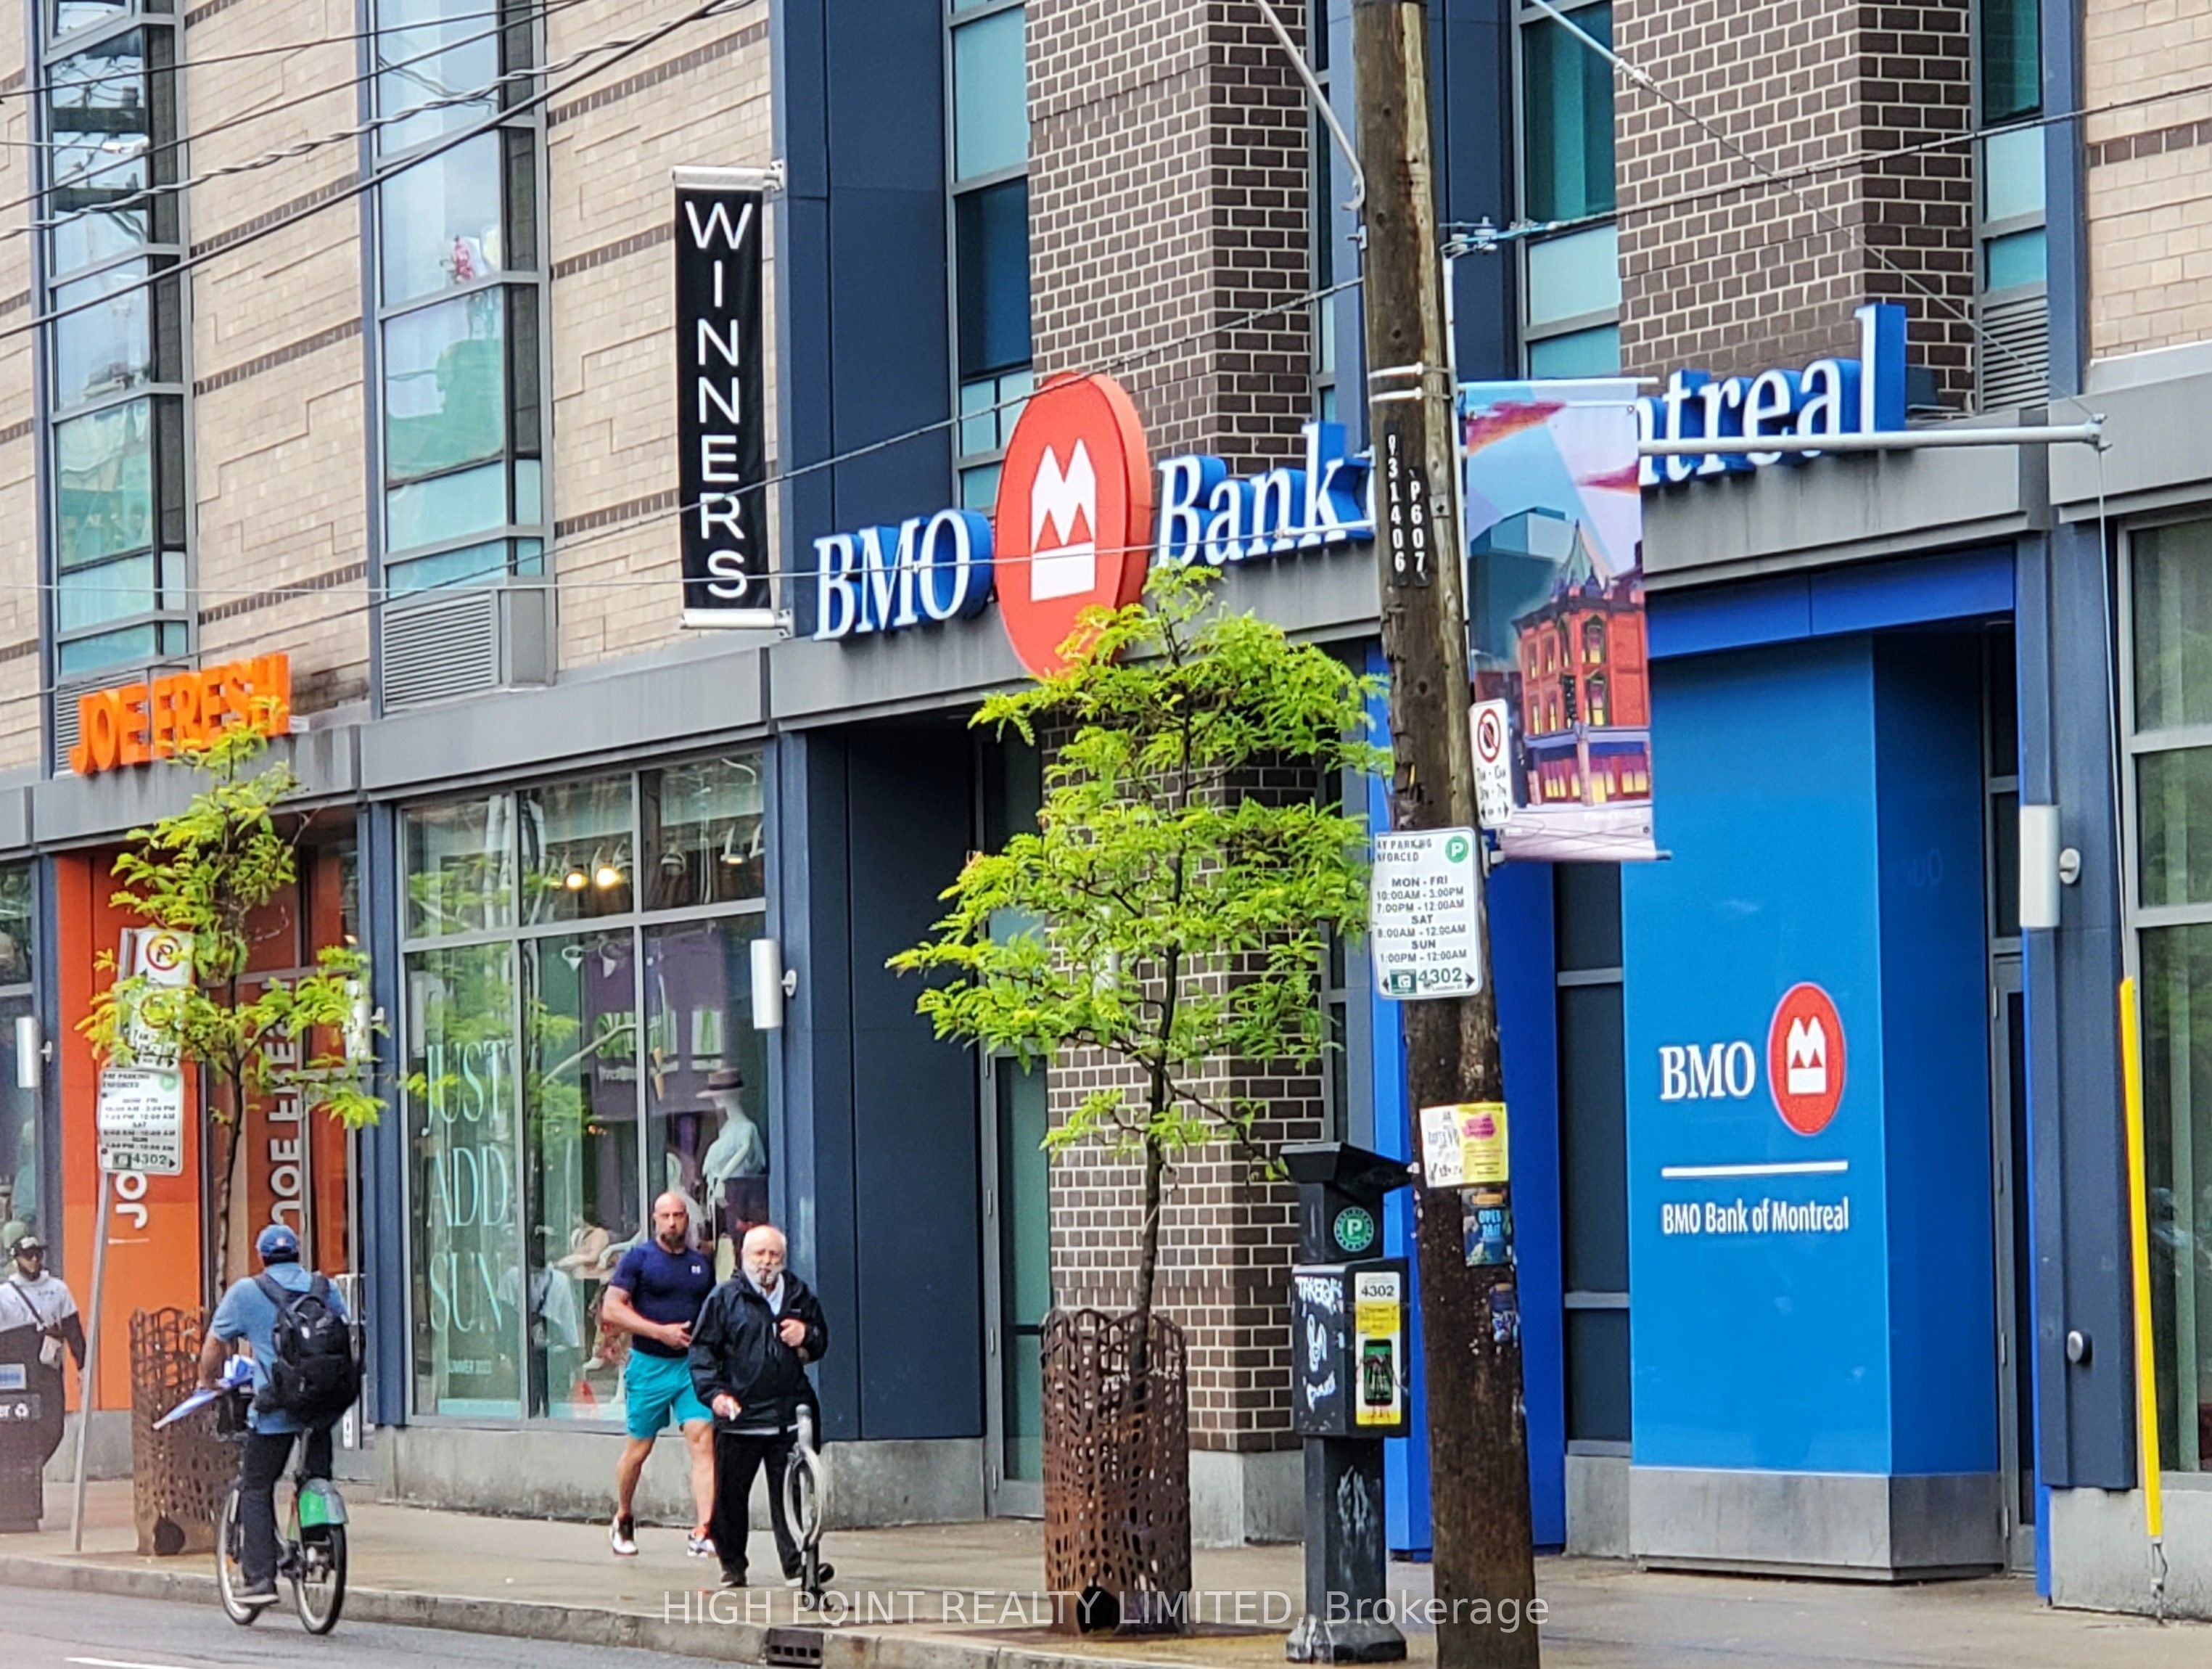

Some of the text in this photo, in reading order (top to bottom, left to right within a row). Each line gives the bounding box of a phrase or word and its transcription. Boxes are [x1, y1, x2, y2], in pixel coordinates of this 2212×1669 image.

[685, 201, 753, 598] WINNERS
[813, 509, 991, 641] BMO
[1159, 421, 1358, 566] Bank
[67, 650, 290, 774] JOE FRESH
[1391, 877, 1420, 887] MON
[1430, 875, 1448, 886] FRI
[1411, 914, 1434, 924] SAT
[1411, 940, 1436, 950] SUN
[1418, 967, 1462, 984] 4302
[422, 1038, 506, 1137] JUST
[1659, 1041, 1756, 1100] BMO
[132, 1153, 168, 1165] 4302
[271, 1138, 300, 1228] JOE
[427, 1146, 508, 1226] ADD
[116, 1170, 147, 1229] JO
[1663, 1196, 1849, 1234] BMO Bank of Montreal
[429, 1252, 502, 1332] SUN
[1361, 1285, 1395, 1297] 4302
